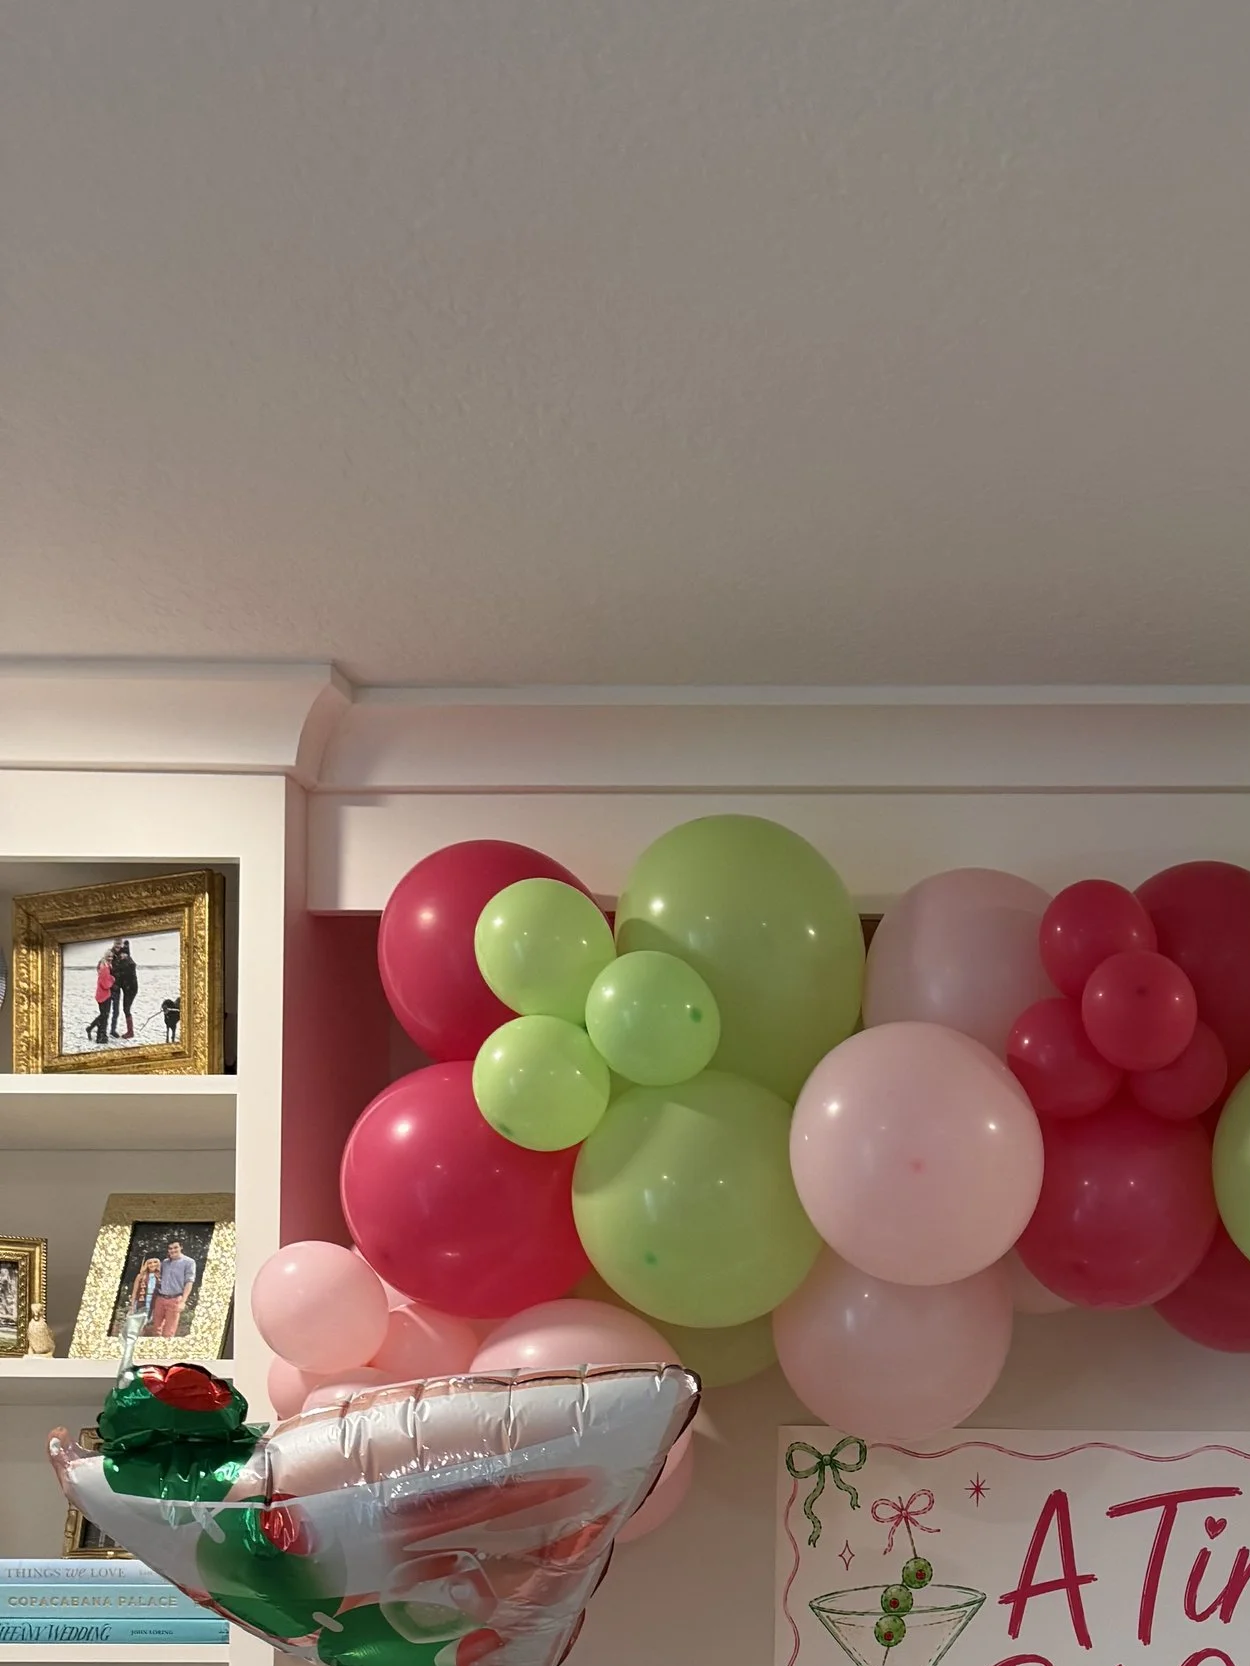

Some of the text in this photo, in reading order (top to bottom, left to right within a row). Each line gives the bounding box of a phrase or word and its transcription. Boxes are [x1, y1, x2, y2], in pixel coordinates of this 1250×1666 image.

[6, 1567, 61, 1579] THINGS
[64, 1567, 89, 1578] we
[90, 1567, 126, 1578] LOVE
[999, 1490, 1097, 1649] A
[7, 1596, 178, 1608] COPACABANA PALACE
[0, 1621, 47, 1641] IFFANY
[48, 1622, 112, 1641] WEDDING
